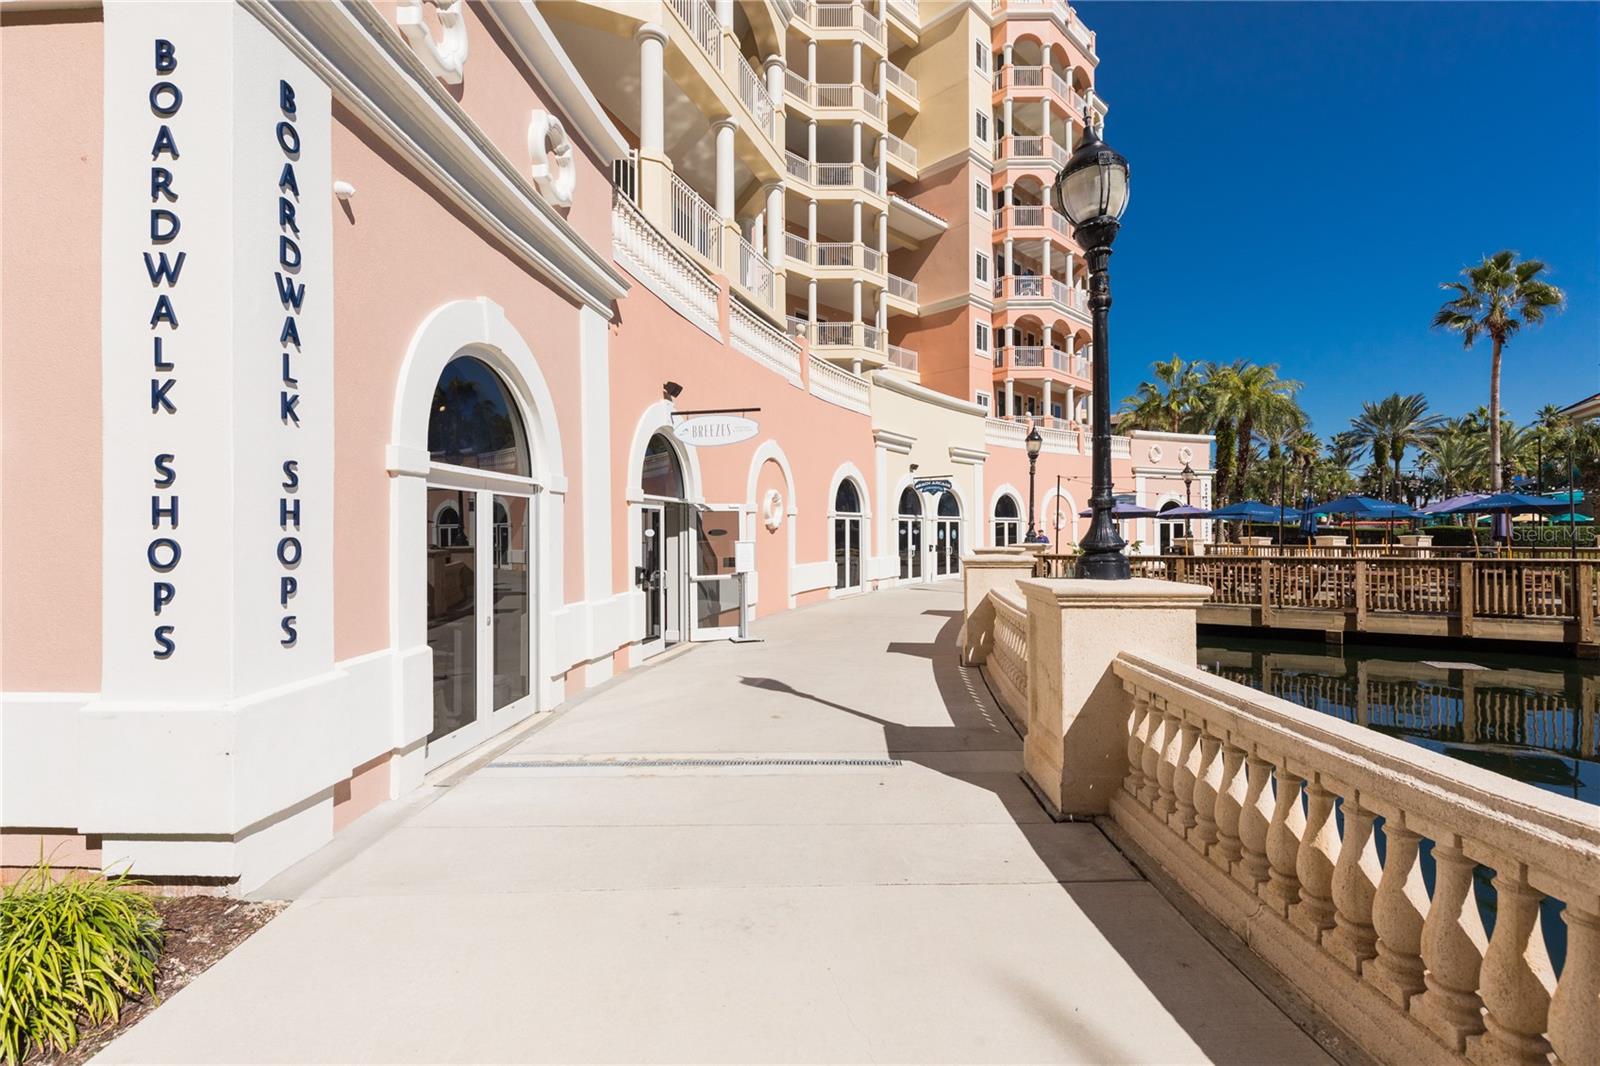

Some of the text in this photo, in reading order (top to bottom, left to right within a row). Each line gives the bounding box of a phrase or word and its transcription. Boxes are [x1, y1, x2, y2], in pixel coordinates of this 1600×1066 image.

[143, 39, 186, 660] BOARDWALK SHOPS
[274, 79, 306, 647] BOARDWALK SHOPS
[692, 423, 731, 438] BREEZES
